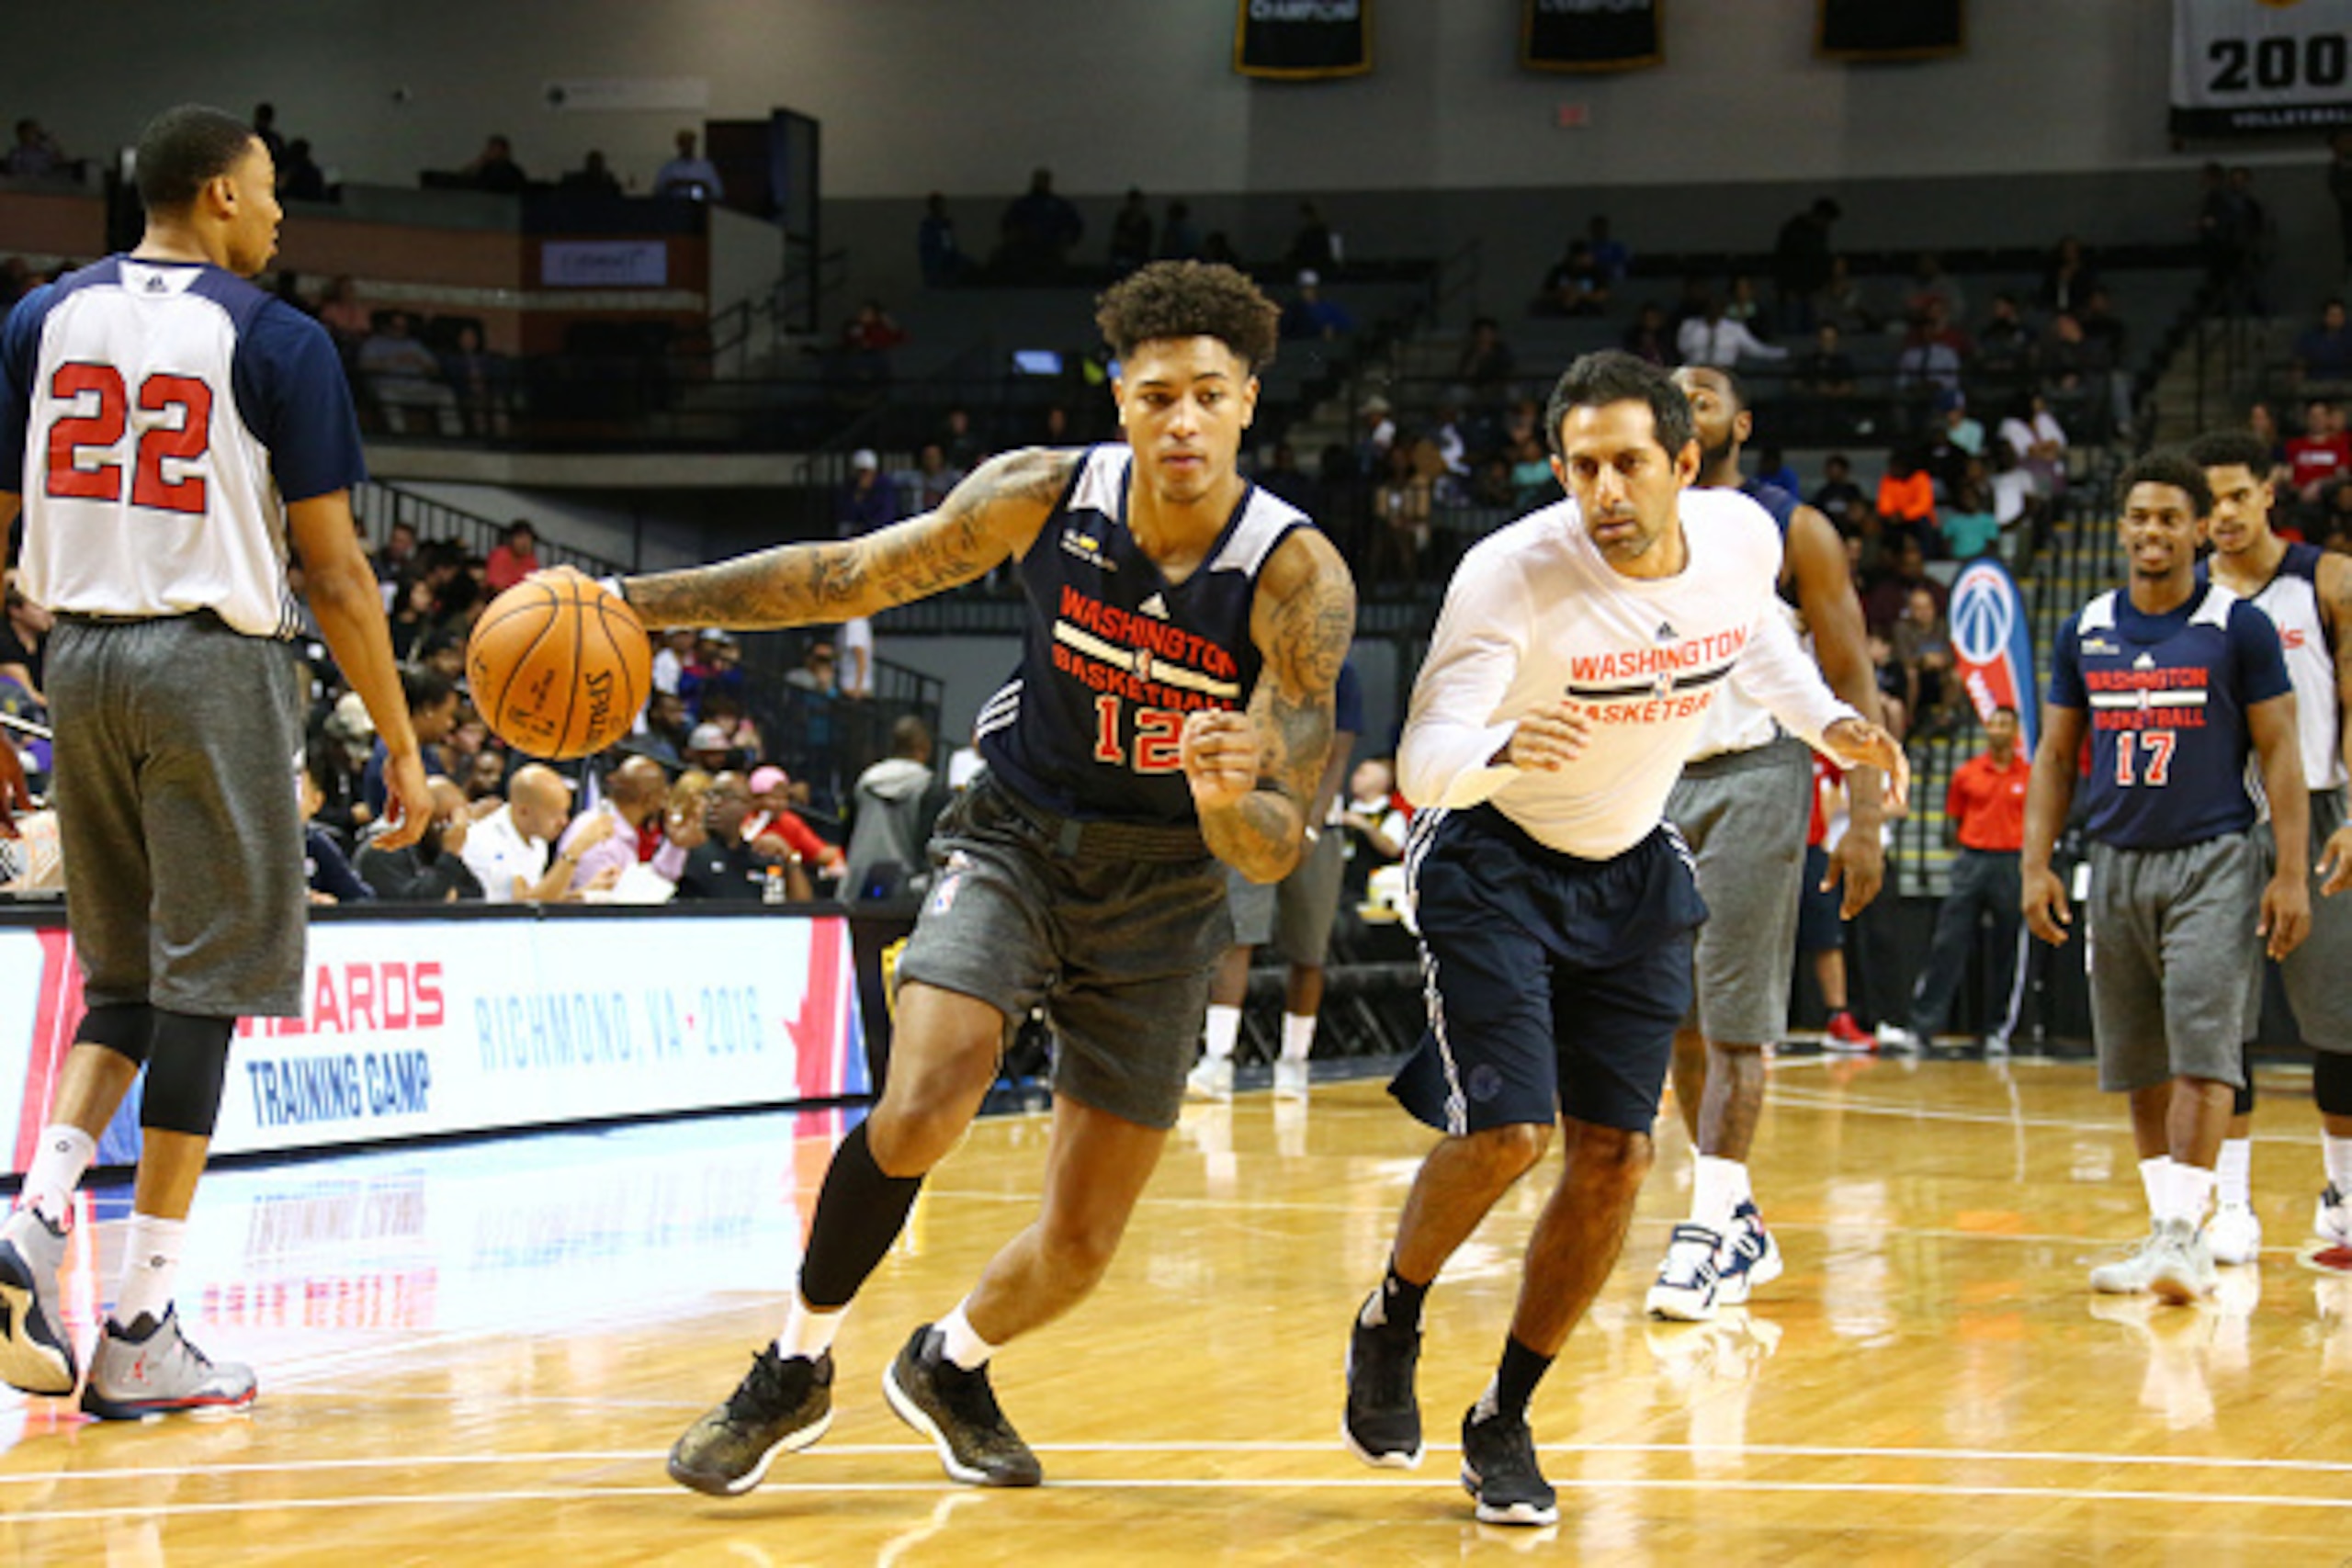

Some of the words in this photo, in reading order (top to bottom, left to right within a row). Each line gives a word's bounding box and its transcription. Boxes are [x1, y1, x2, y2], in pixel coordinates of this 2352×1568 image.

[46, 361, 213, 514] 22
[1059, 584, 1238, 677] WASHINGTON
[1571, 625, 1747, 681] WASHINGTON
[1560, 688, 1717, 725] ASKETBA
[2085, 667, 2209, 691] WASHINGTON
[1093, 694, 1185, 773] 12
[2093, 706, 2208, 730] BASKETBALL
[2115, 729, 2177, 787] 17
[236, 961, 445, 1038] ARDS
[245, 1052, 362, 1128] TRAINING
[364, 1047, 431, 1117] CAMP
